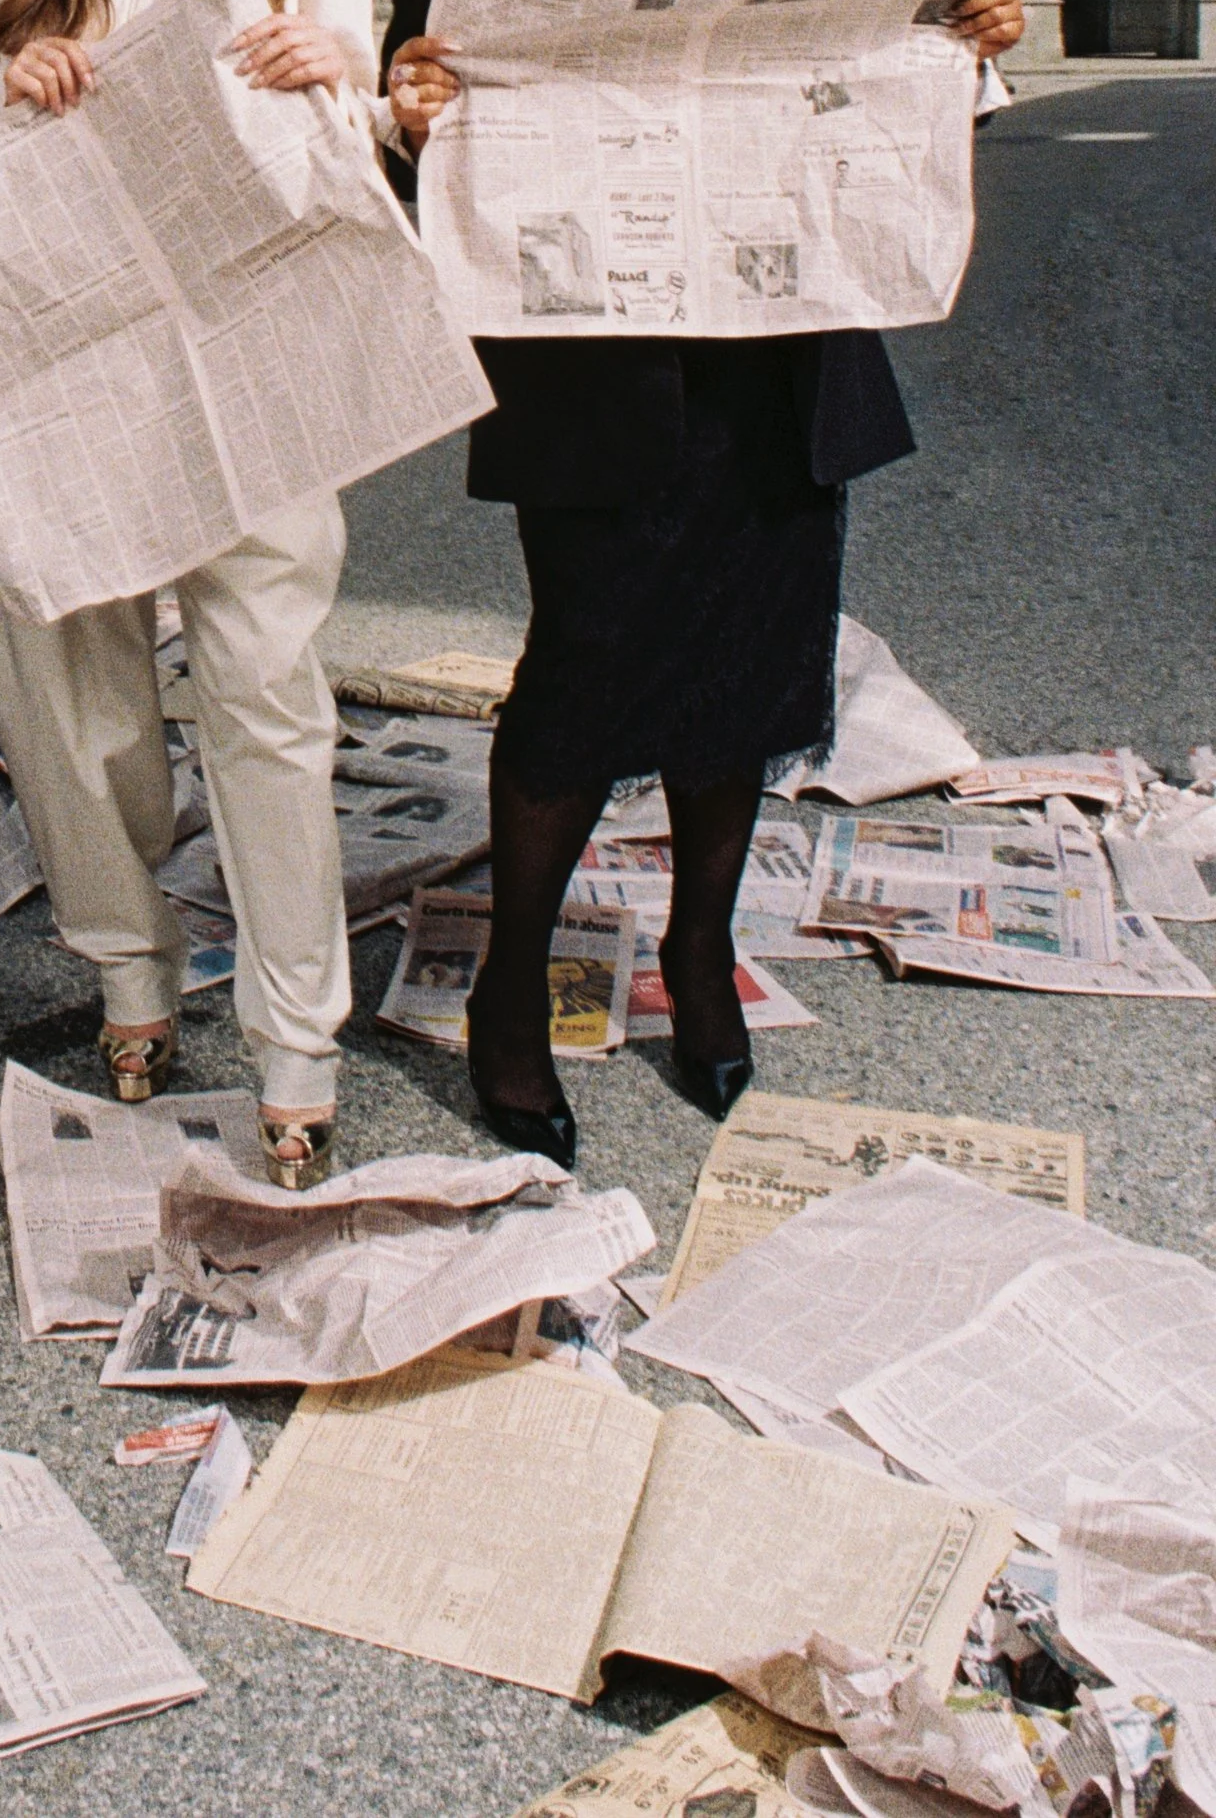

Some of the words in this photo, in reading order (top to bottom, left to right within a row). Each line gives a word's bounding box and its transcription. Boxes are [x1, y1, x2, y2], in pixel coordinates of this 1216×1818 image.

[607, 270, 649, 283] PALACE
[422, 903, 465, 919] Courts
[564, 915, 578, 930] in
[580, 920, 621, 934] abuse
[555, 1023, 597, 1034] KING
[710, 1170, 752, 1188] up.
[757, 1176, 832, 1199] going
[724, 1188, 806, 1215] prices
